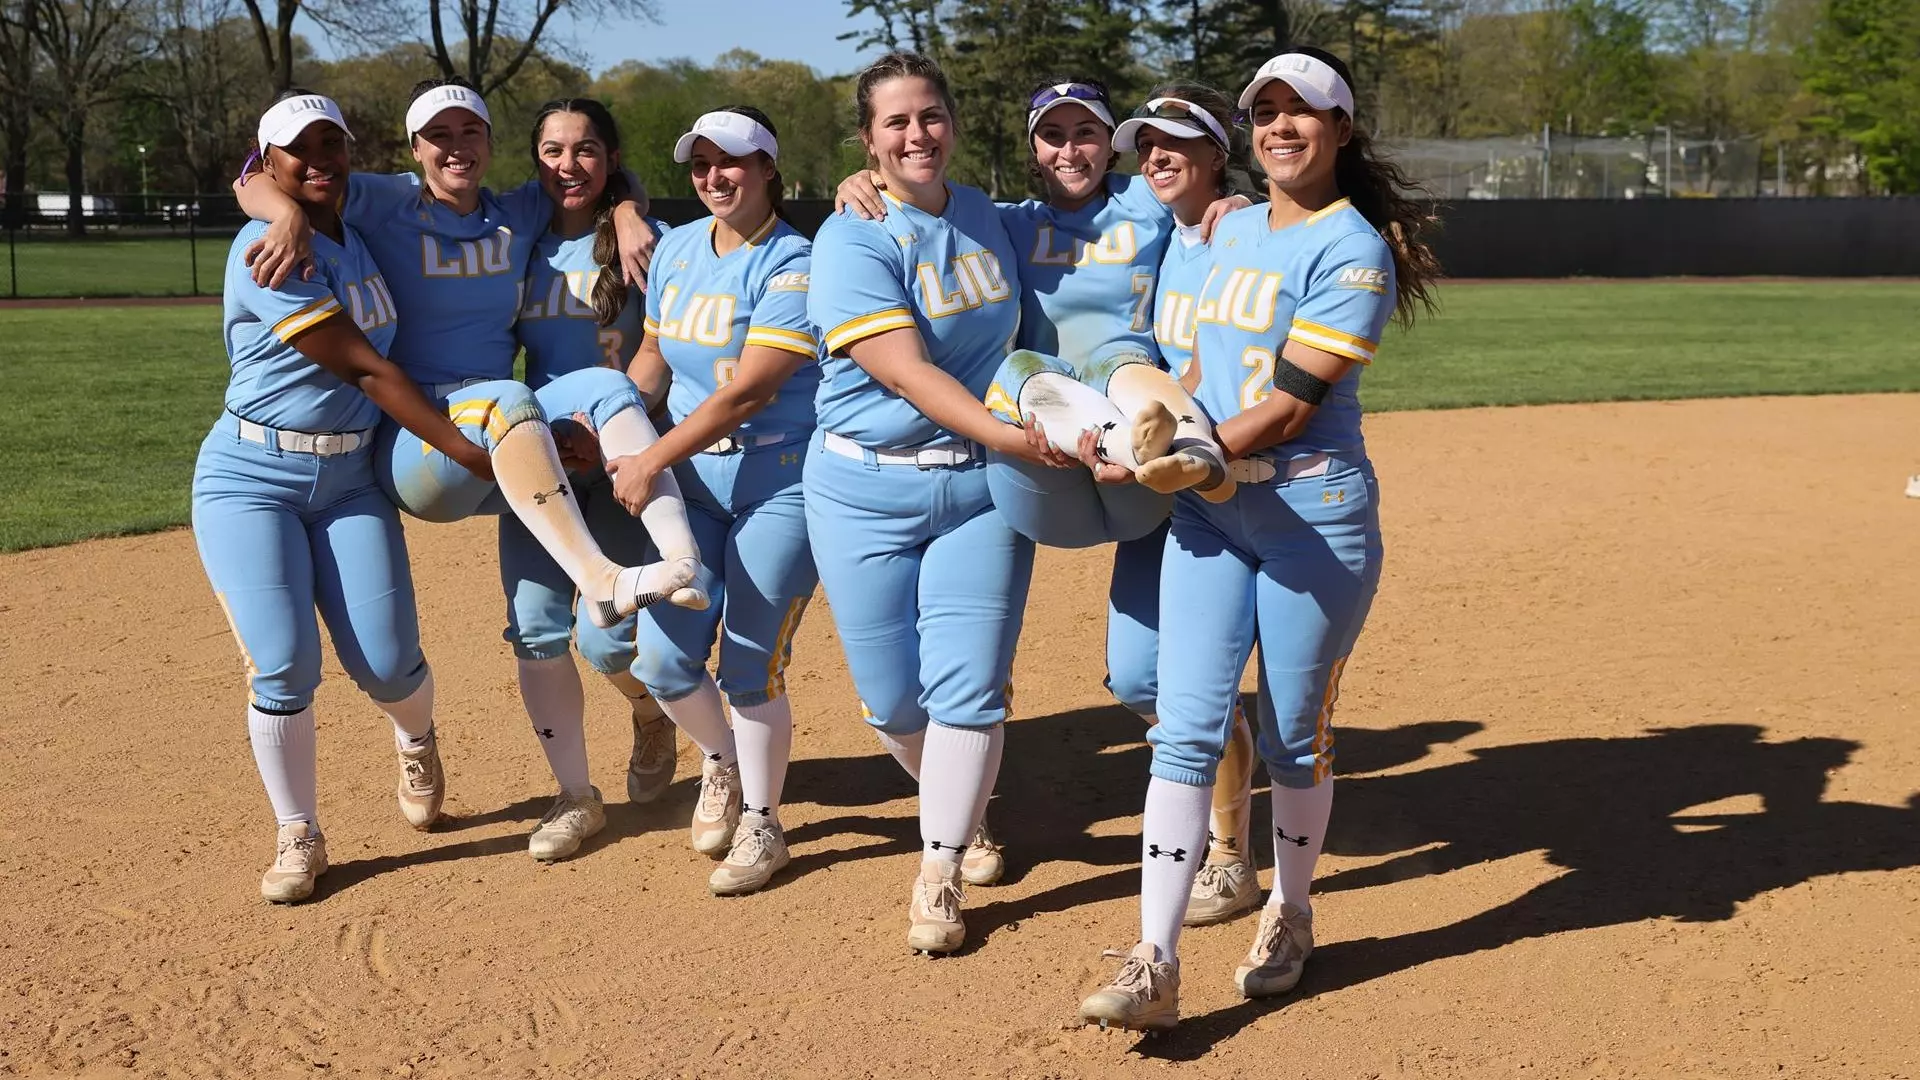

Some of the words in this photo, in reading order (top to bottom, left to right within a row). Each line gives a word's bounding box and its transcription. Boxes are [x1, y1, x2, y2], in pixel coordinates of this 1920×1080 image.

[288, 98, 326, 114] LIU
[431, 88, 466, 105] LIU
[421, 226, 512, 278] LIU
[1031, 220, 1137, 267] LIU
[917, 249, 1011, 319] LIU
[1130, 273, 1154, 333] 7
[1196, 266, 1283, 333] LIU
[1337, 266, 1389, 286] NEC
[658, 285, 736, 348] LIU
[1153, 290, 1198, 351] IU
[1240, 345, 1275, 410] 2
